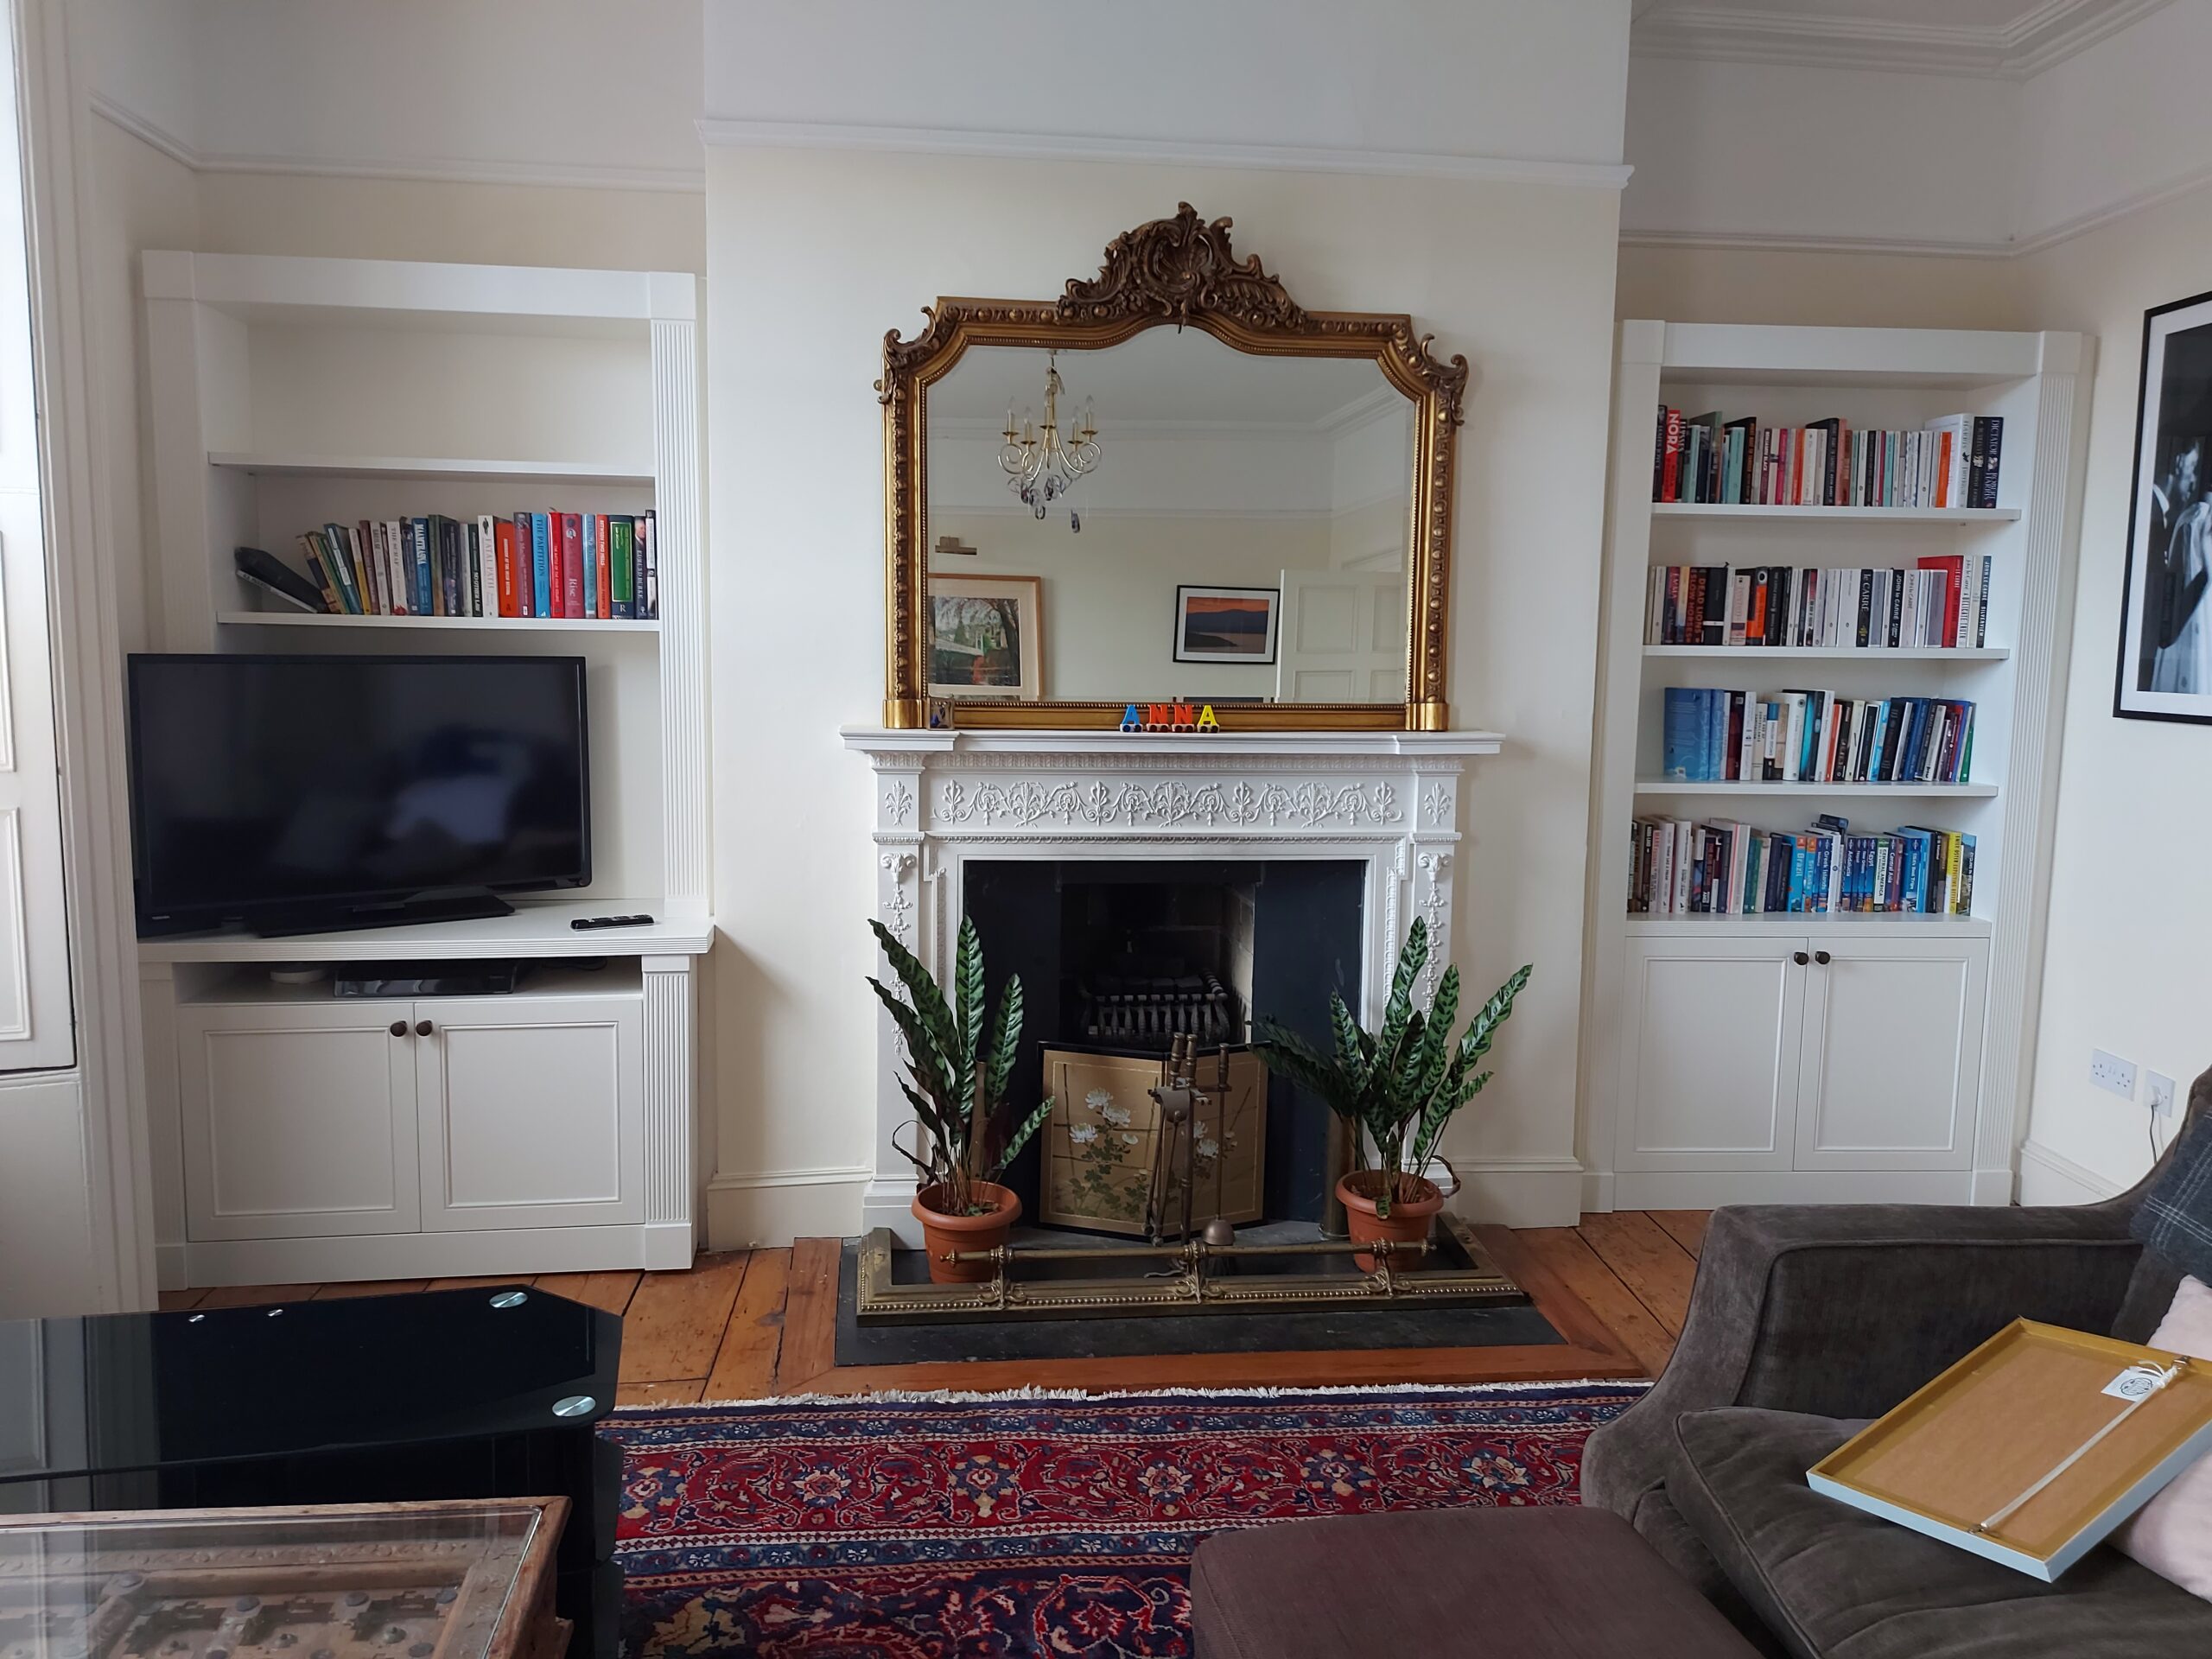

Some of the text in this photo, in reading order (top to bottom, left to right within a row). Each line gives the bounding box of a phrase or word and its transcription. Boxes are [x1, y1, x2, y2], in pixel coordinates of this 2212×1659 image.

[1666, 413, 1680, 454] NORA
[1989, 420, 2000, 455] DICTATOR
[1984, 473, 1993, 500] HARRIS
[536, 518, 544, 533] THE
[537, 536, 546, 577] PARTITION
[1686, 574, 1697, 637] SLOW HORSES
[1960, 596, 1970, 621] DELICATE
[1694, 607, 1704, 633] LIONS
[1960, 622, 1968, 639] TRUTH
[1122, 704, 1217, 725] ANNA
[1796, 853, 1804, 877] Brazil
